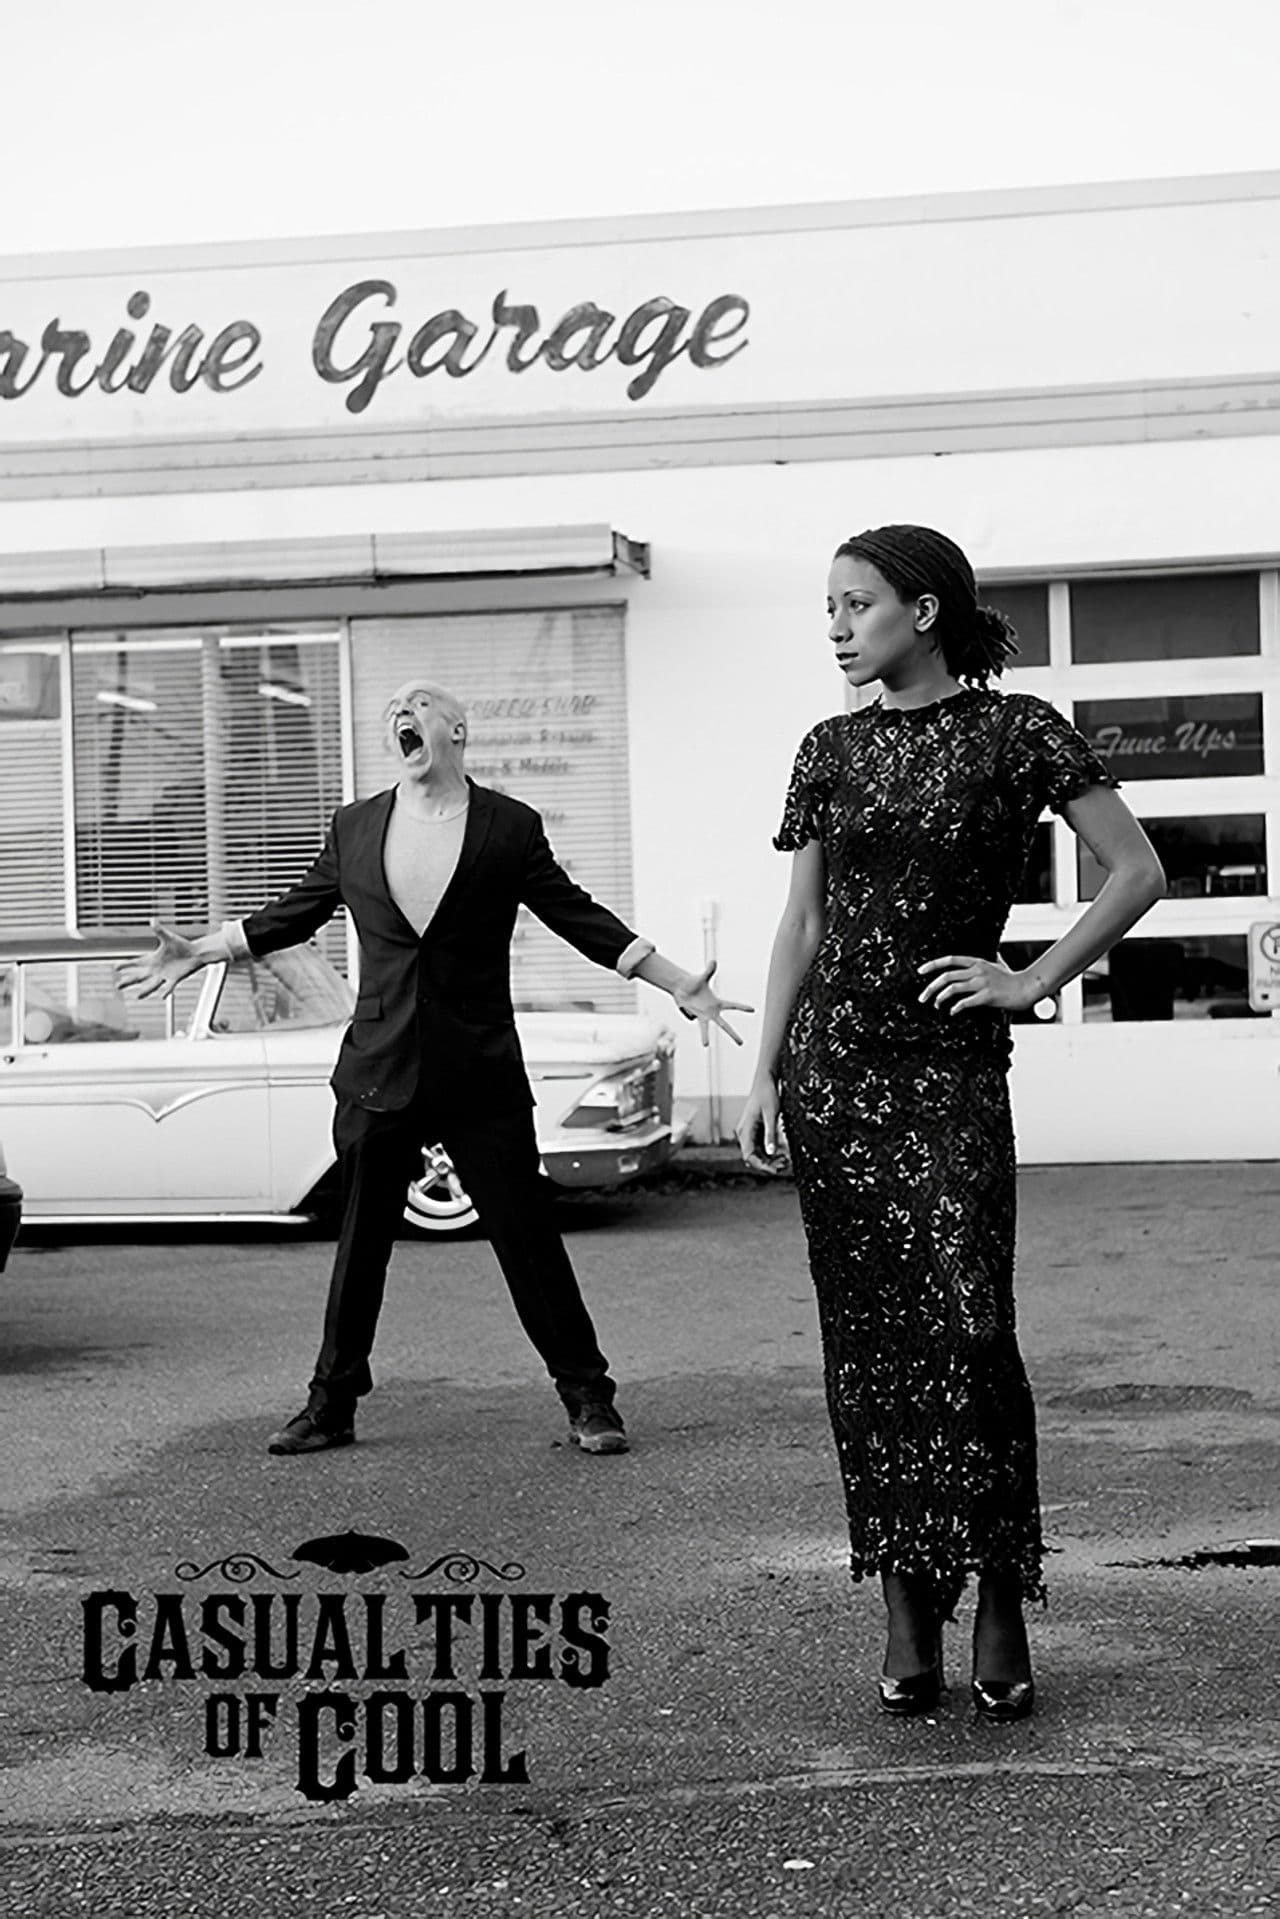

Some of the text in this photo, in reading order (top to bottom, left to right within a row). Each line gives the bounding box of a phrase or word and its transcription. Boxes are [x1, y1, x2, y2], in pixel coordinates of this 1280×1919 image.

[312, 279, 749, 413] Garage
[1096, 721, 1236, 758] Tune Ups
